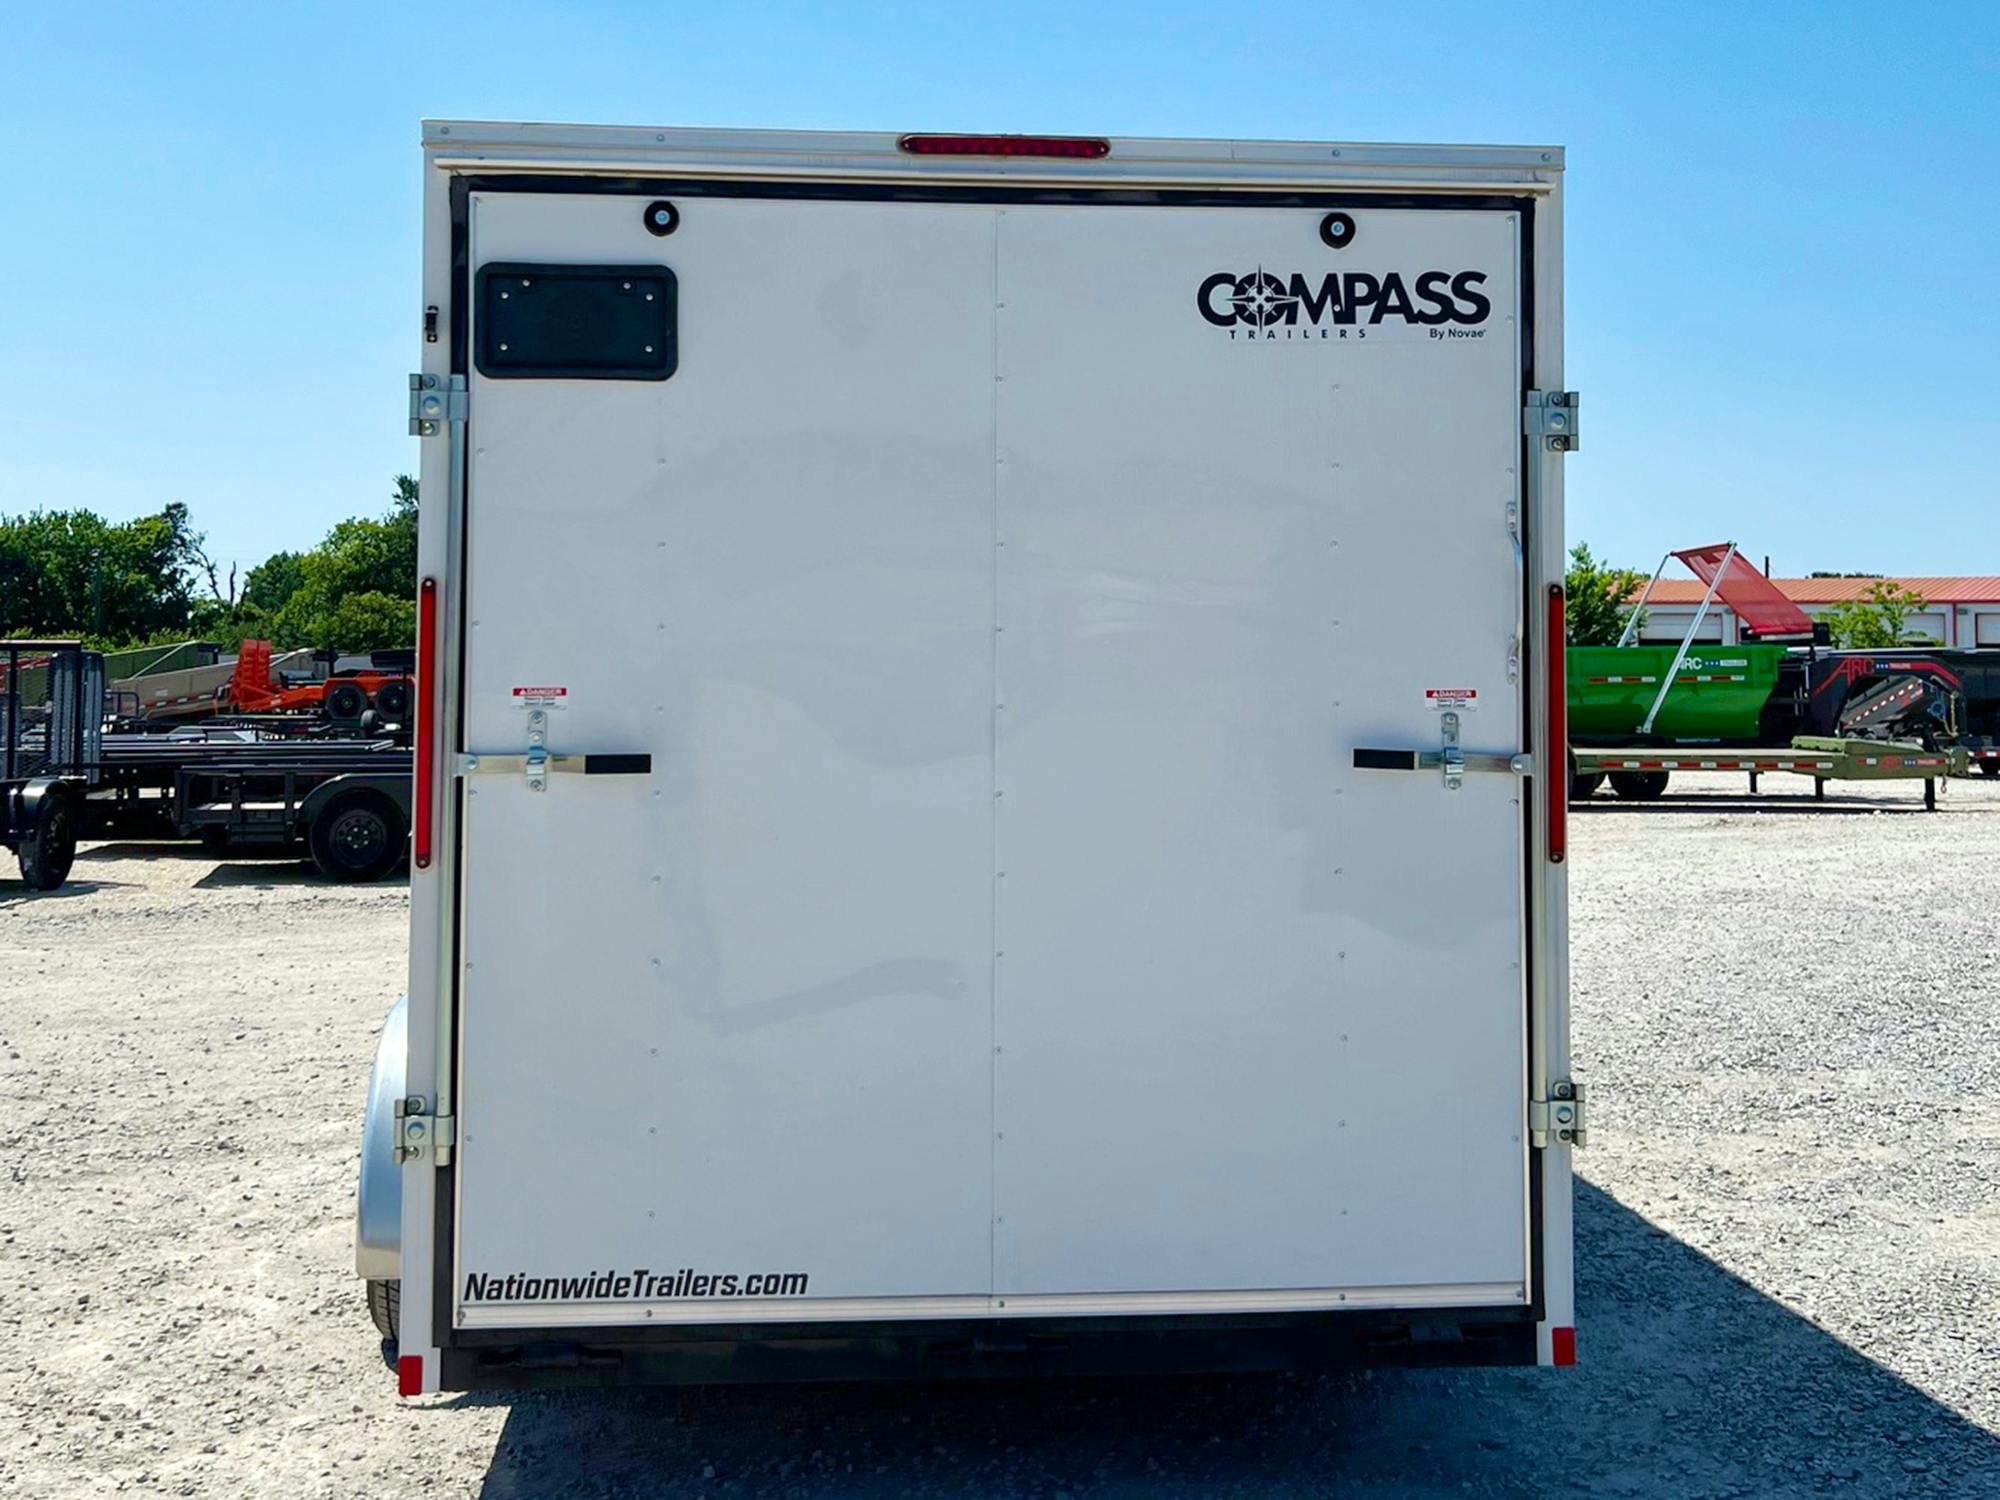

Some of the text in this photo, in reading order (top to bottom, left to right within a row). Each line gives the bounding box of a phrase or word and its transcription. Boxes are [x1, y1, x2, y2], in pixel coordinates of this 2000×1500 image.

[1197, 271, 1491, 327] COMPASS
[1229, 329, 1366, 340] TRAILERS
[1430, 328, 1484, 340] By Novae
[464, 1269, 808, 1300] NationwideTrailers.com
